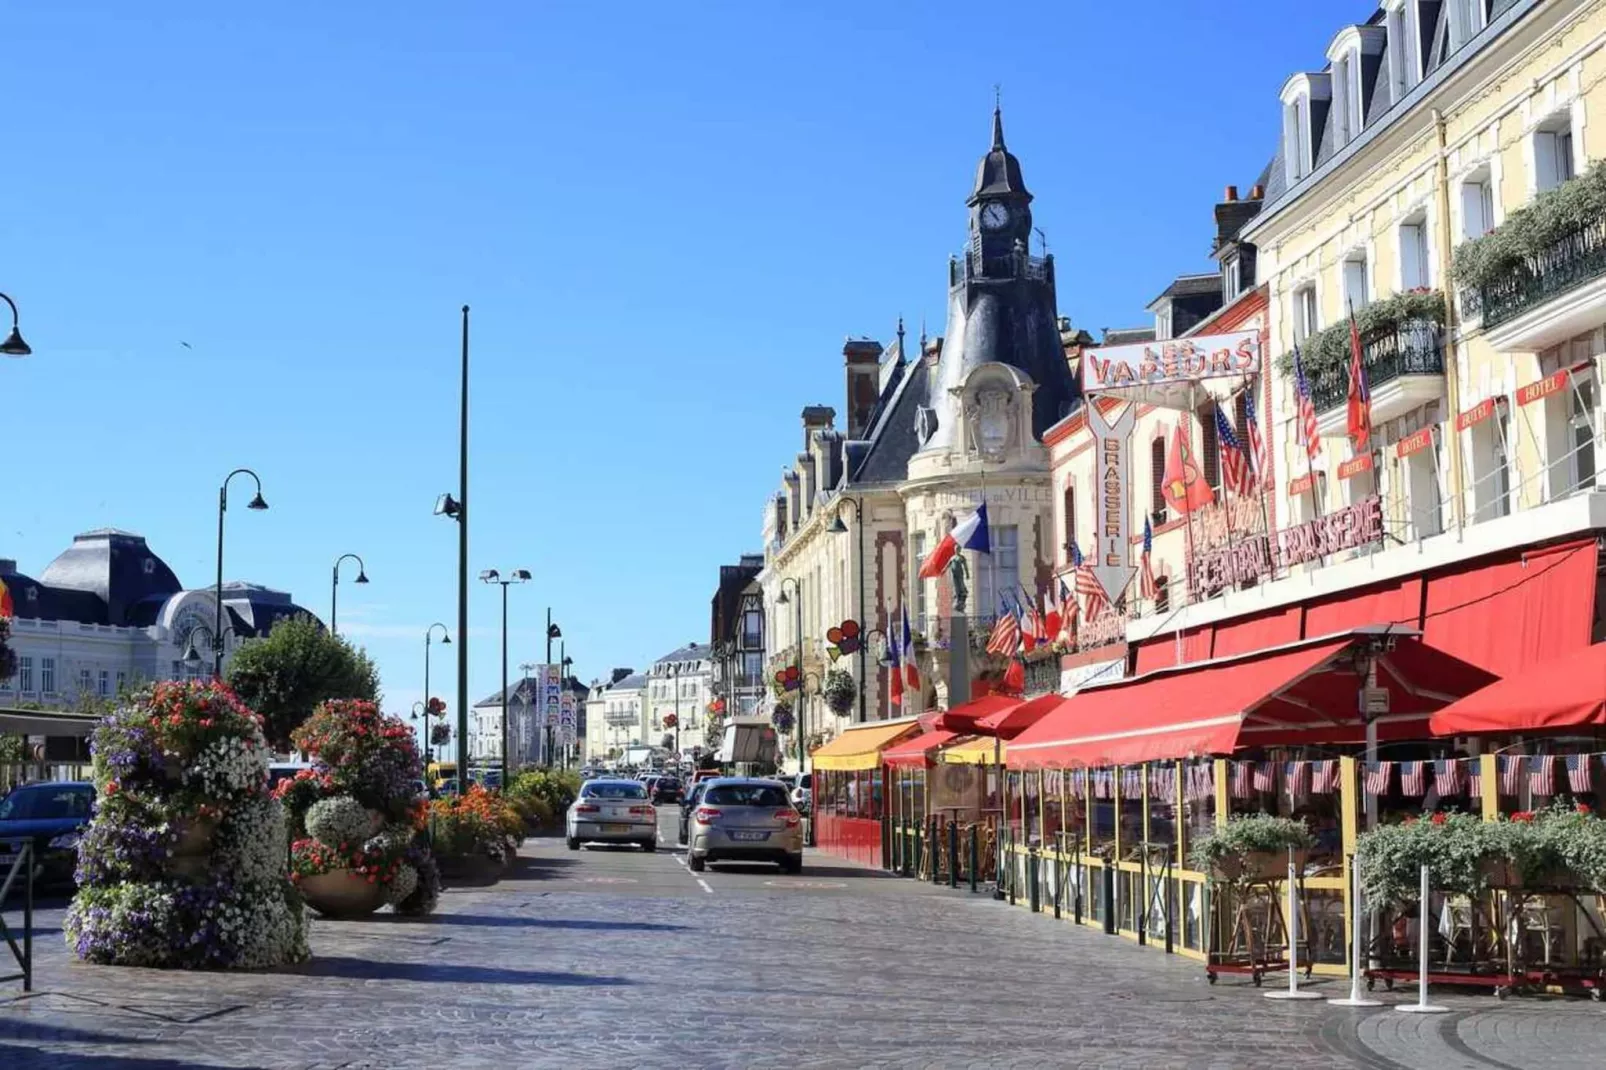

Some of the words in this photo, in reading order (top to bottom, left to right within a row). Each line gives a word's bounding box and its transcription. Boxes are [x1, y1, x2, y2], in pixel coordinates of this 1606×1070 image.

[1090, 337, 1254, 385] VAPEURS
[1525, 377, 1558, 401] HOTEL
[1462, 405, 1490, 428] HOTEL
[1402, 434, 1425, 455] HOTEL
[1005, 487, 1053, 502] VILLE
[1104, 437, 1121, 567] BRASSERIE
